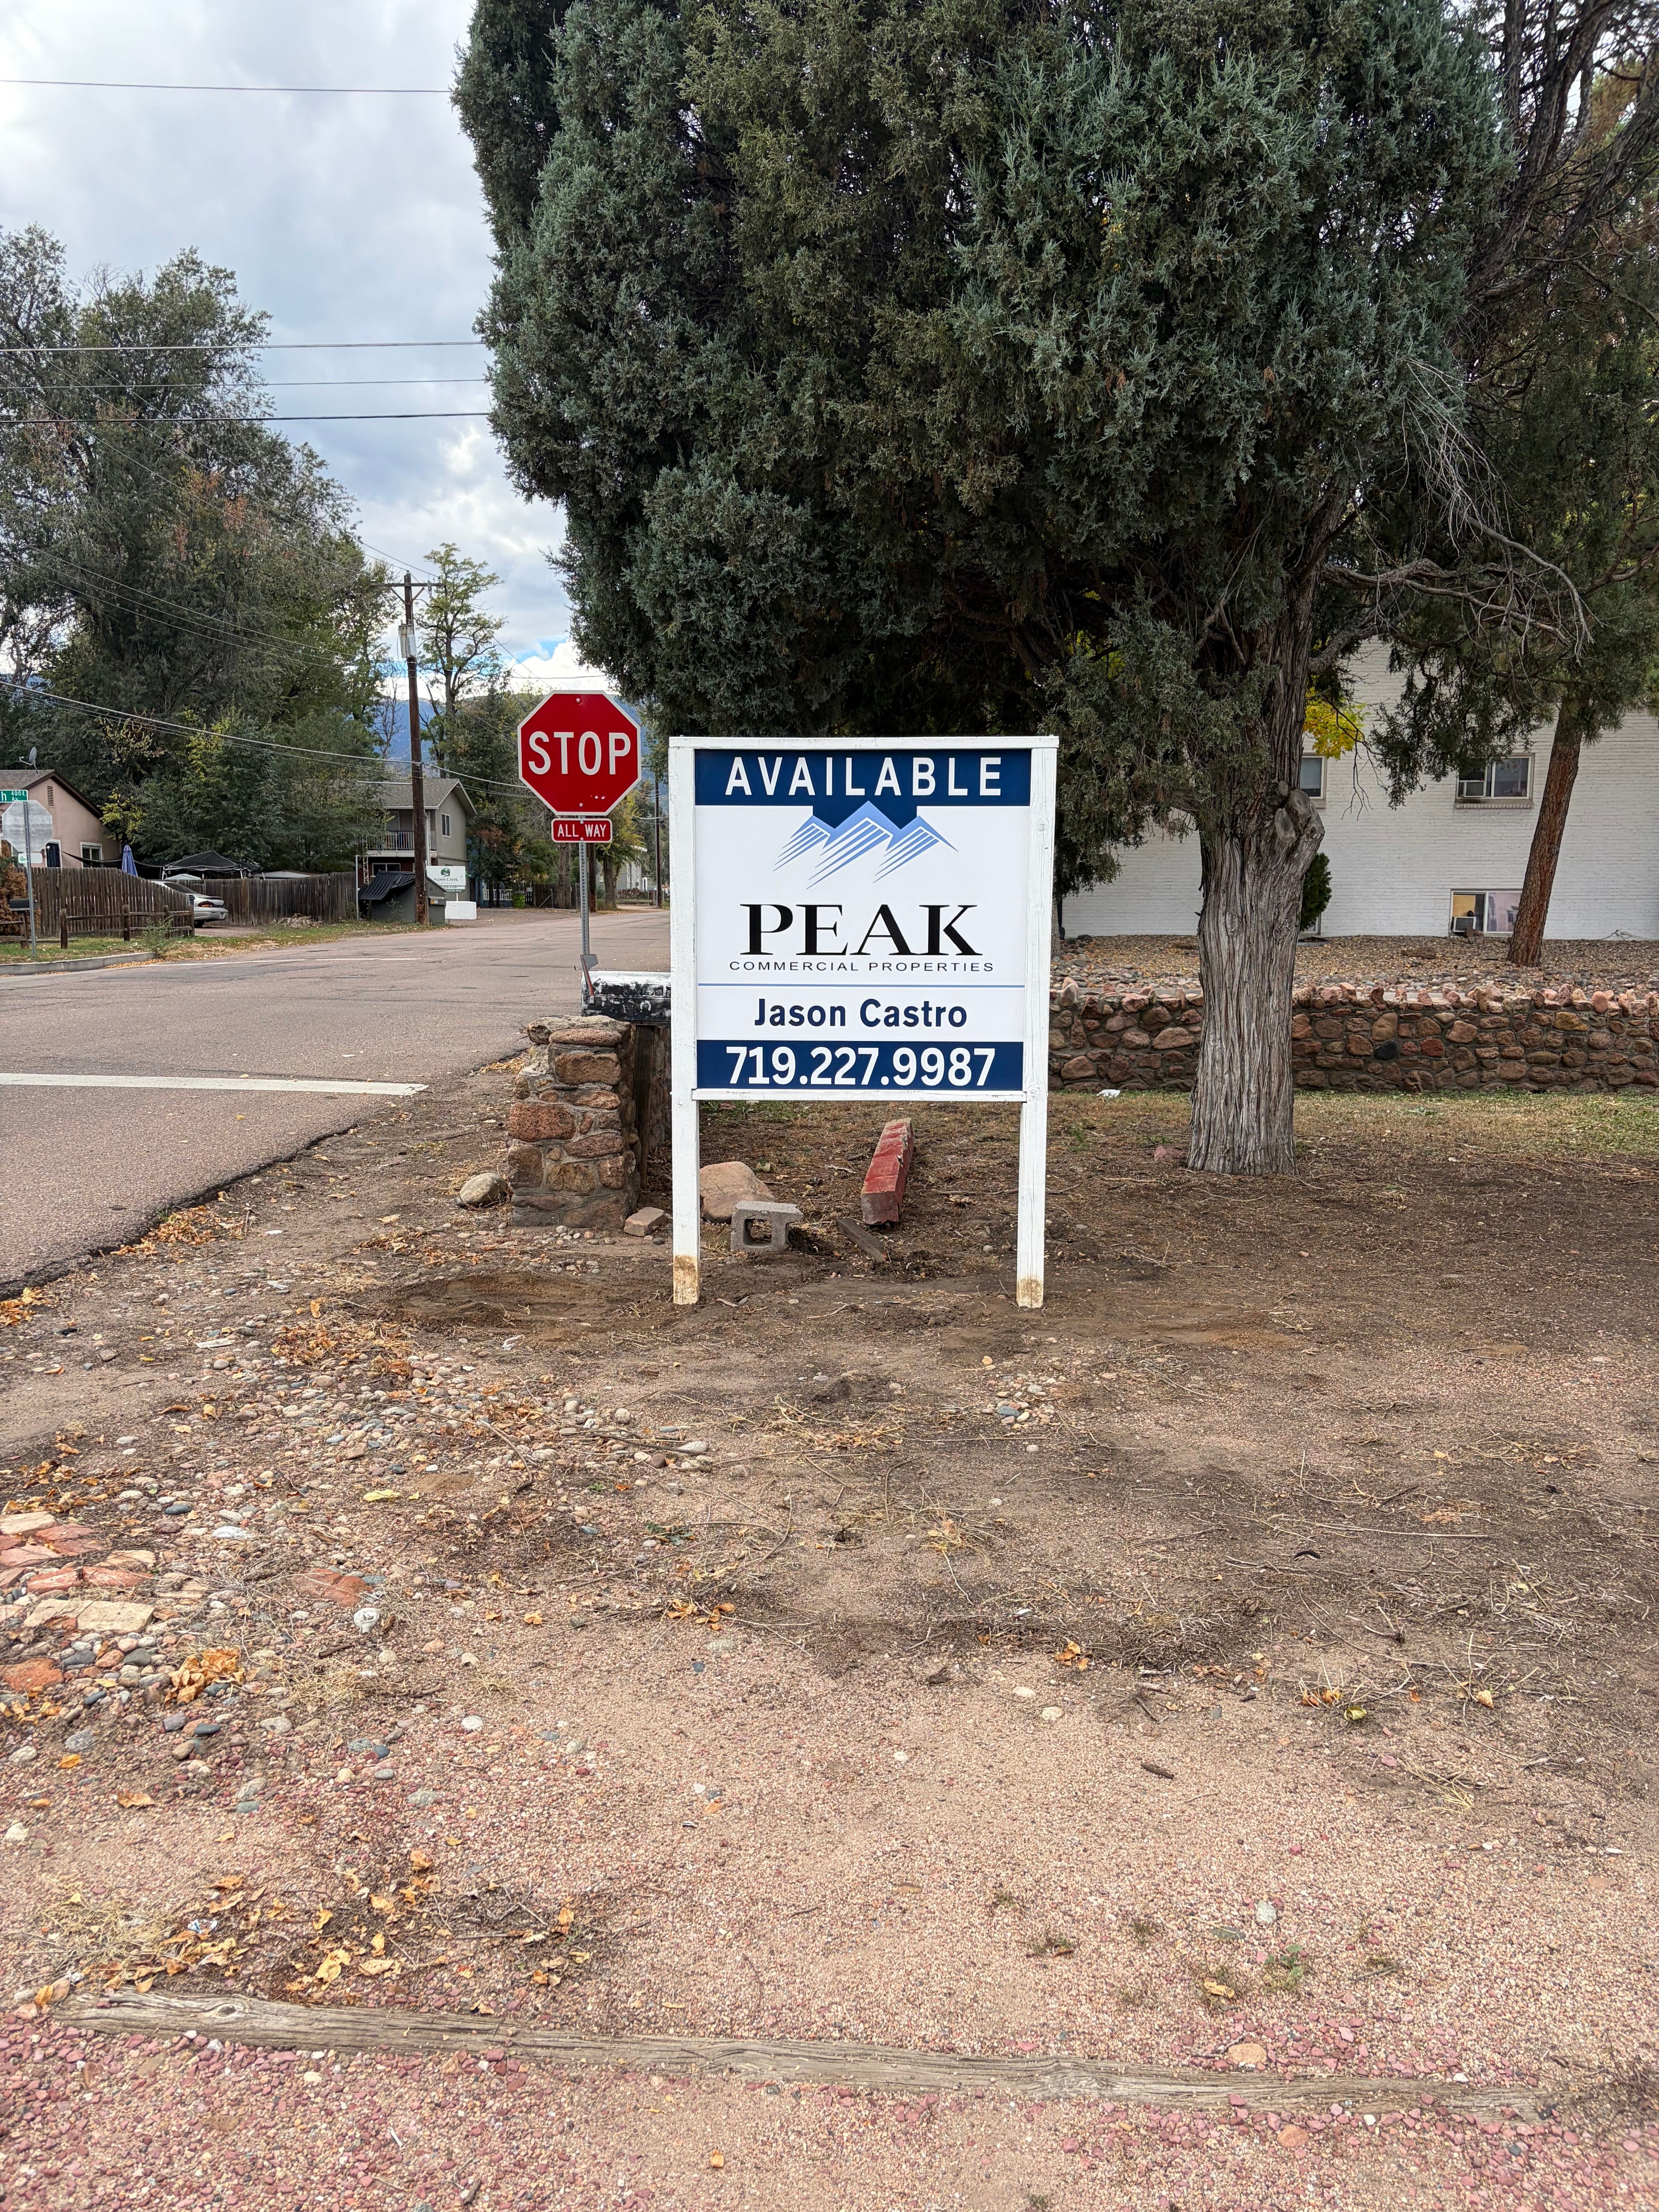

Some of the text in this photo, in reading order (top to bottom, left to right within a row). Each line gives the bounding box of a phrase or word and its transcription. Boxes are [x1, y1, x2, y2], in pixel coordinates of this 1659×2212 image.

[529, 731, 630, 775] STOP
[725, 757, 1001, 796] AVAILABLE
[557, 824, 606, 837] ALL WAY
[740, 904, 983, 956] PEAK
[730, 961, 993, 972] COMMERCIAL PROPERTIES
[755, 998, 967, 1027] Jason Castro
[726, 1046, 995, 1086] 719.227.9987
